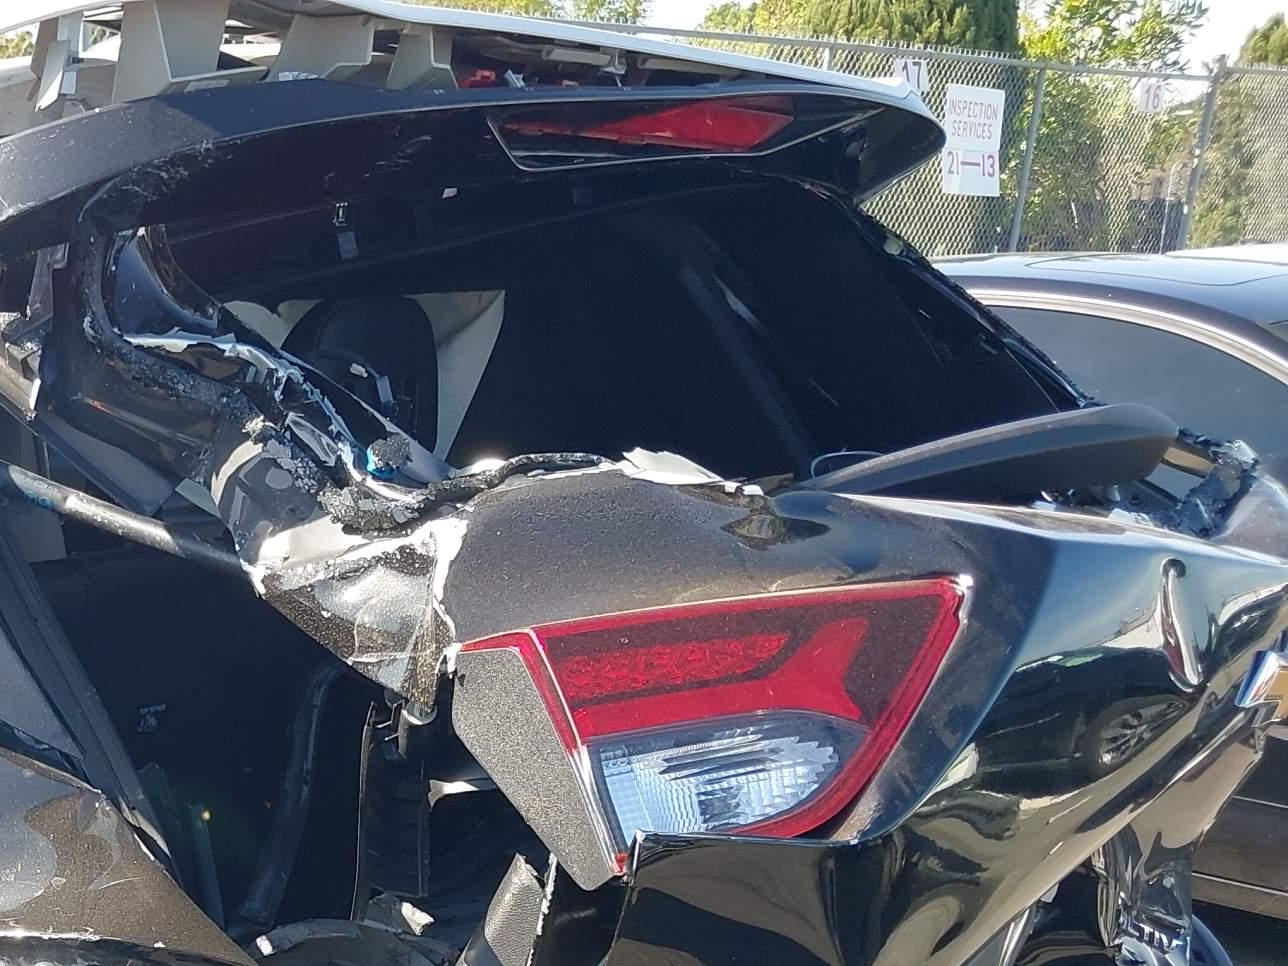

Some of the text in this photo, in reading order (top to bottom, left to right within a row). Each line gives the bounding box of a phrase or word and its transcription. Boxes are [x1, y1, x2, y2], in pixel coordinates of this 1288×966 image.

[902, 61, 922, 89] 17
[1144, 83, 1162, 110] 16
[948, 99, 999, 120] INSPECTION
[951, 120, 993, 140] SERVICES
